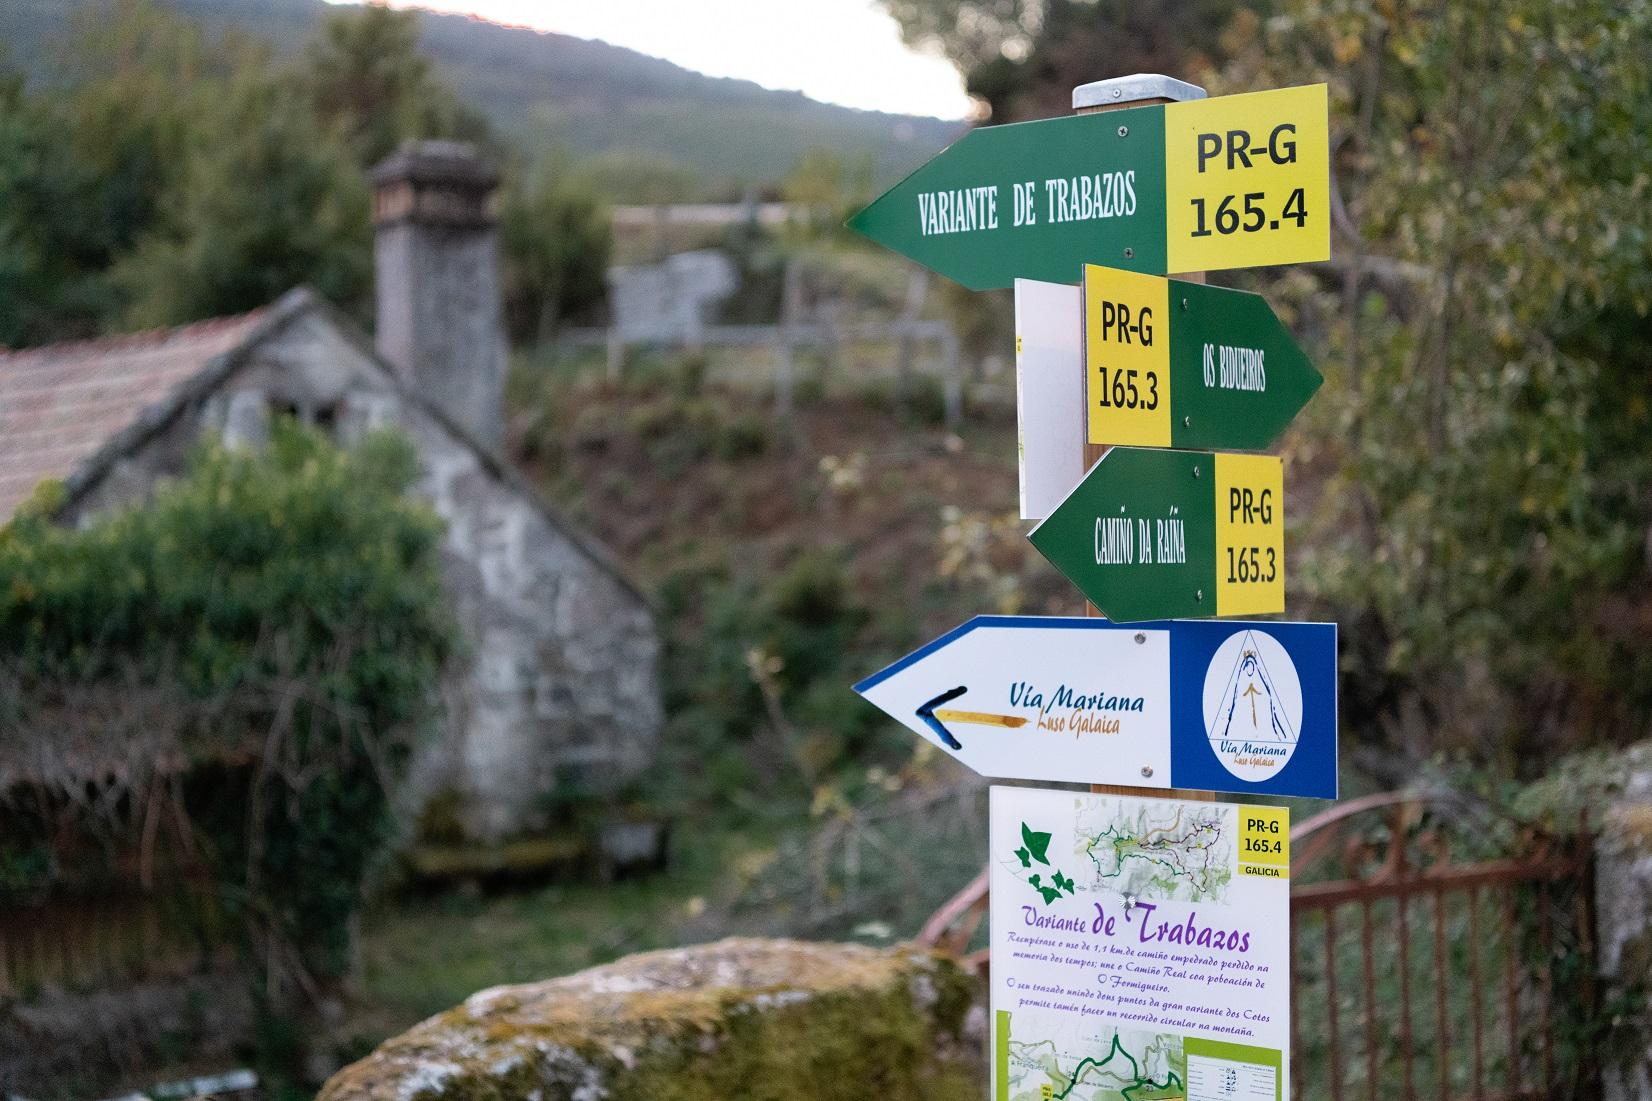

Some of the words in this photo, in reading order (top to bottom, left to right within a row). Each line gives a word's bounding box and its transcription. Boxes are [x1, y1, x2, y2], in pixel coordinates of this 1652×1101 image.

[1196, 123, 1297, 174] PR-G
[918, 186, 998, 236] VARIANTE
[1013, 182, 1036, 227] DE
[1046, 170, 1137, 221] TRABAZOS
[1190, 188, 1308, 238] 165.4
[1102, 301, 1153, 347] PR-G
[1203, 343, 1215, 388] OS
[1219, 345, 1266, 392] BIDUEIROS
[1099, 367, 1159, 411] 165.3
[1230, 487, 1272, 525] PR-G
[1094, 504, 1134, 564] CAMIÑO
[1139, 518, 1152, 564] DA
[1157, 505, 1186, 564] RAÍÑA
[1227, 547, 1276, 583] 165.3
[1009, 682, 1043, 708] Vía
[1045, 684, 1145, 714] Mariana
[1037, 704, 1065, 733] Luso
[1069, 708, 1121, 739] Galaica
[1220, 740, 1237, 754] Vía
[1238, 742, 1287, 756] Mariana
[1249, 755, 1275, 768] Galaica
[1247, 818, 1279, 834] PR-G
[1245, 838, 1281, 854] 165.4
[1245, 866, 1280, 878] GALICIA
[1022, 905, 1086, 933] Variante
[1092, 902, 1116, 936] de
[1125, 901, 1250, 952] Trabazos
[1013, 951, 1048, 961] memoria
[1050, 953, 1063, 963] dos
[1125, 961, 1161, 976] Camiño
[1163, 966, 1187, 979] Real
[1189, 973, 1205, 981] coa
[1207, 974, 1252, 987] poboación
[1255, 978, 1265, 989] de
[1081, 941, 1090, 951] de
[1137, 950, 1168, 961] camiño
[1171, 954, 1218, 966] empedrado
[1221, 959, 1254, 971] perdido
[1097, 973, 1108, 984] O
[1006, 977, 1016, 988] O
[1066, 988, 1094, 999] unindo
[1117, 995, 1146, 1007] puntos
[1149, 997, 1159, 1007] da
[1162, 1001, 1183, 1012] gran
[1185, 1005, 1223, 1017] variante
[1226, 1007, 1240, 1018] dos
[1243, 1009, 1270, 1023] Cotos
[1019, 998, 1051, 1008] permite
[1107, 1010, 1117, 1018] un
[1120, 1012, 1158, 1024] recorrido
[1160, 1017, 1196, 1029] circular
[1199, 1022, 1210, 1030] na
[1212, 1025, 1255, 1037] montaña.
